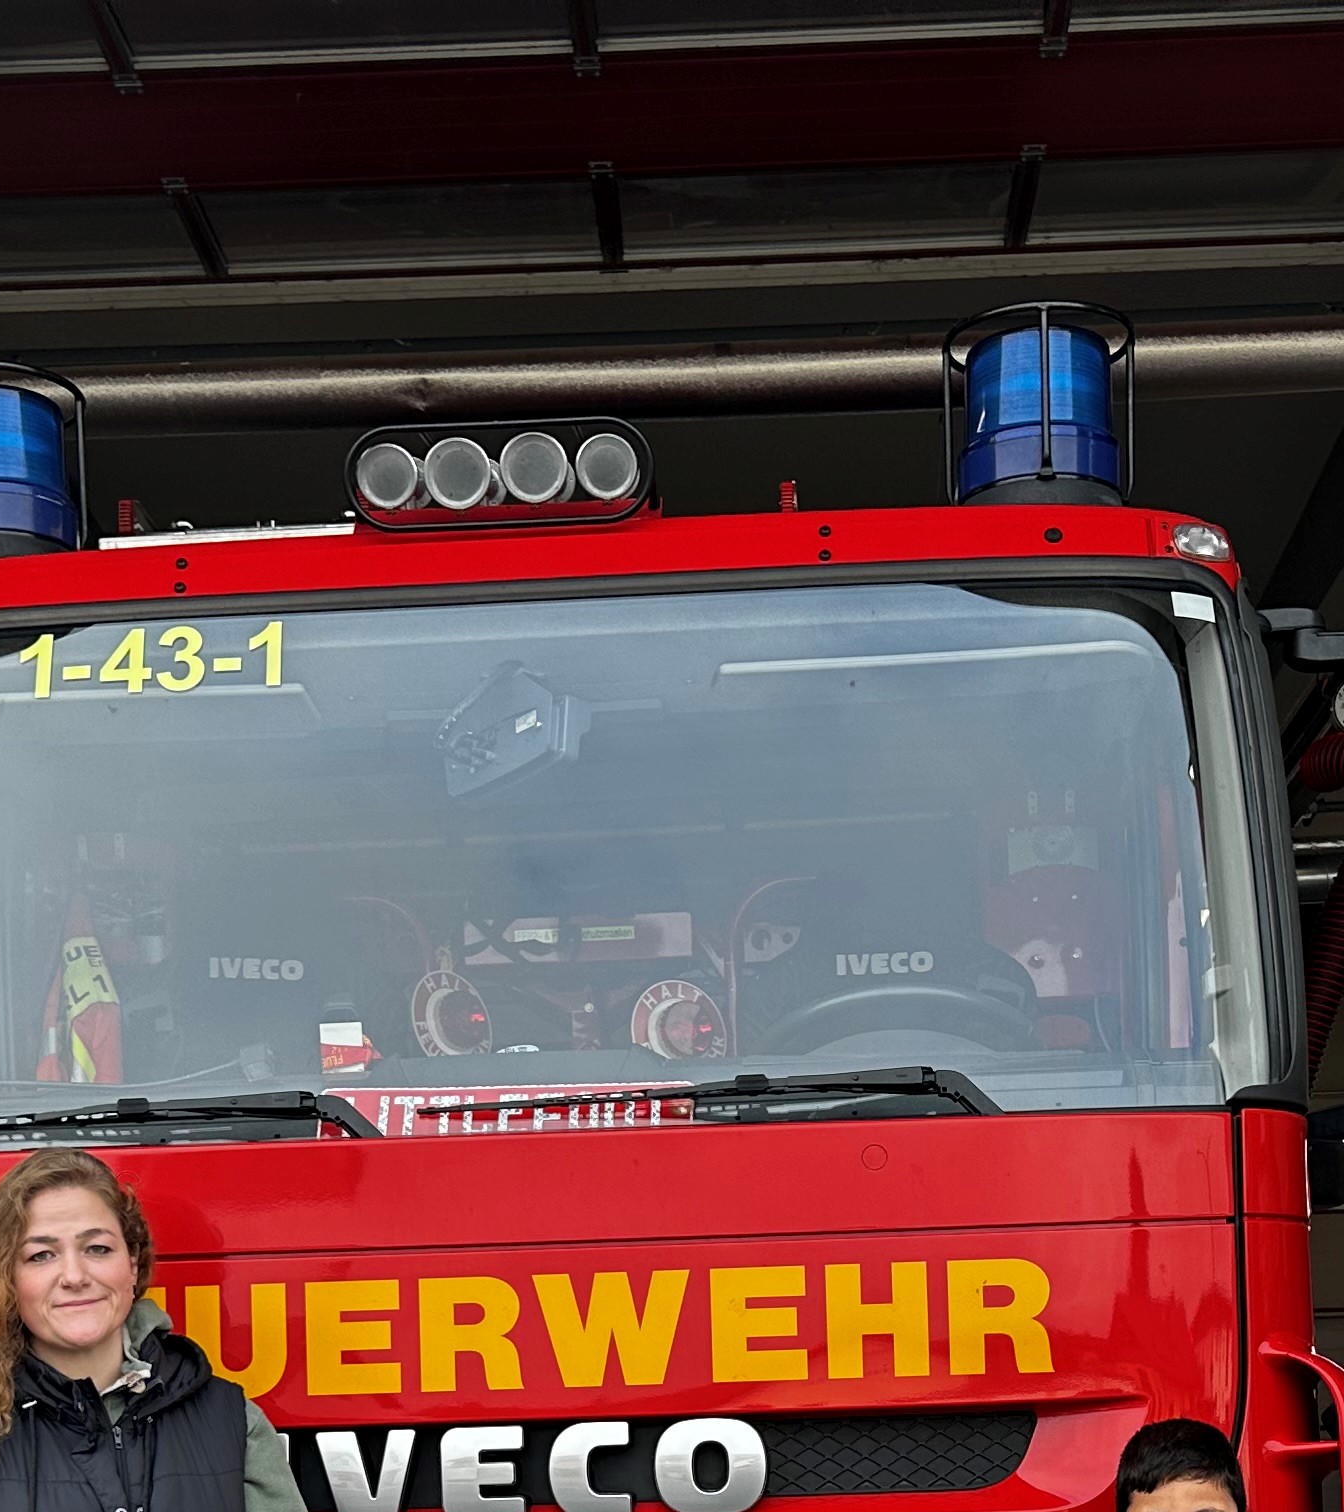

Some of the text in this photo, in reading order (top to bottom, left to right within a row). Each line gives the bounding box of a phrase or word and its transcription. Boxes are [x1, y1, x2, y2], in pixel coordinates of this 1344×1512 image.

[19, 621, 284, 699] 1-43-1
[209, 957, 304, 981] IVECO
[835, 951, 934, 976] IVECO
[642, 983, 703, 1010] HALT
[145, 1258, 1056, 1399] UERWEHR
